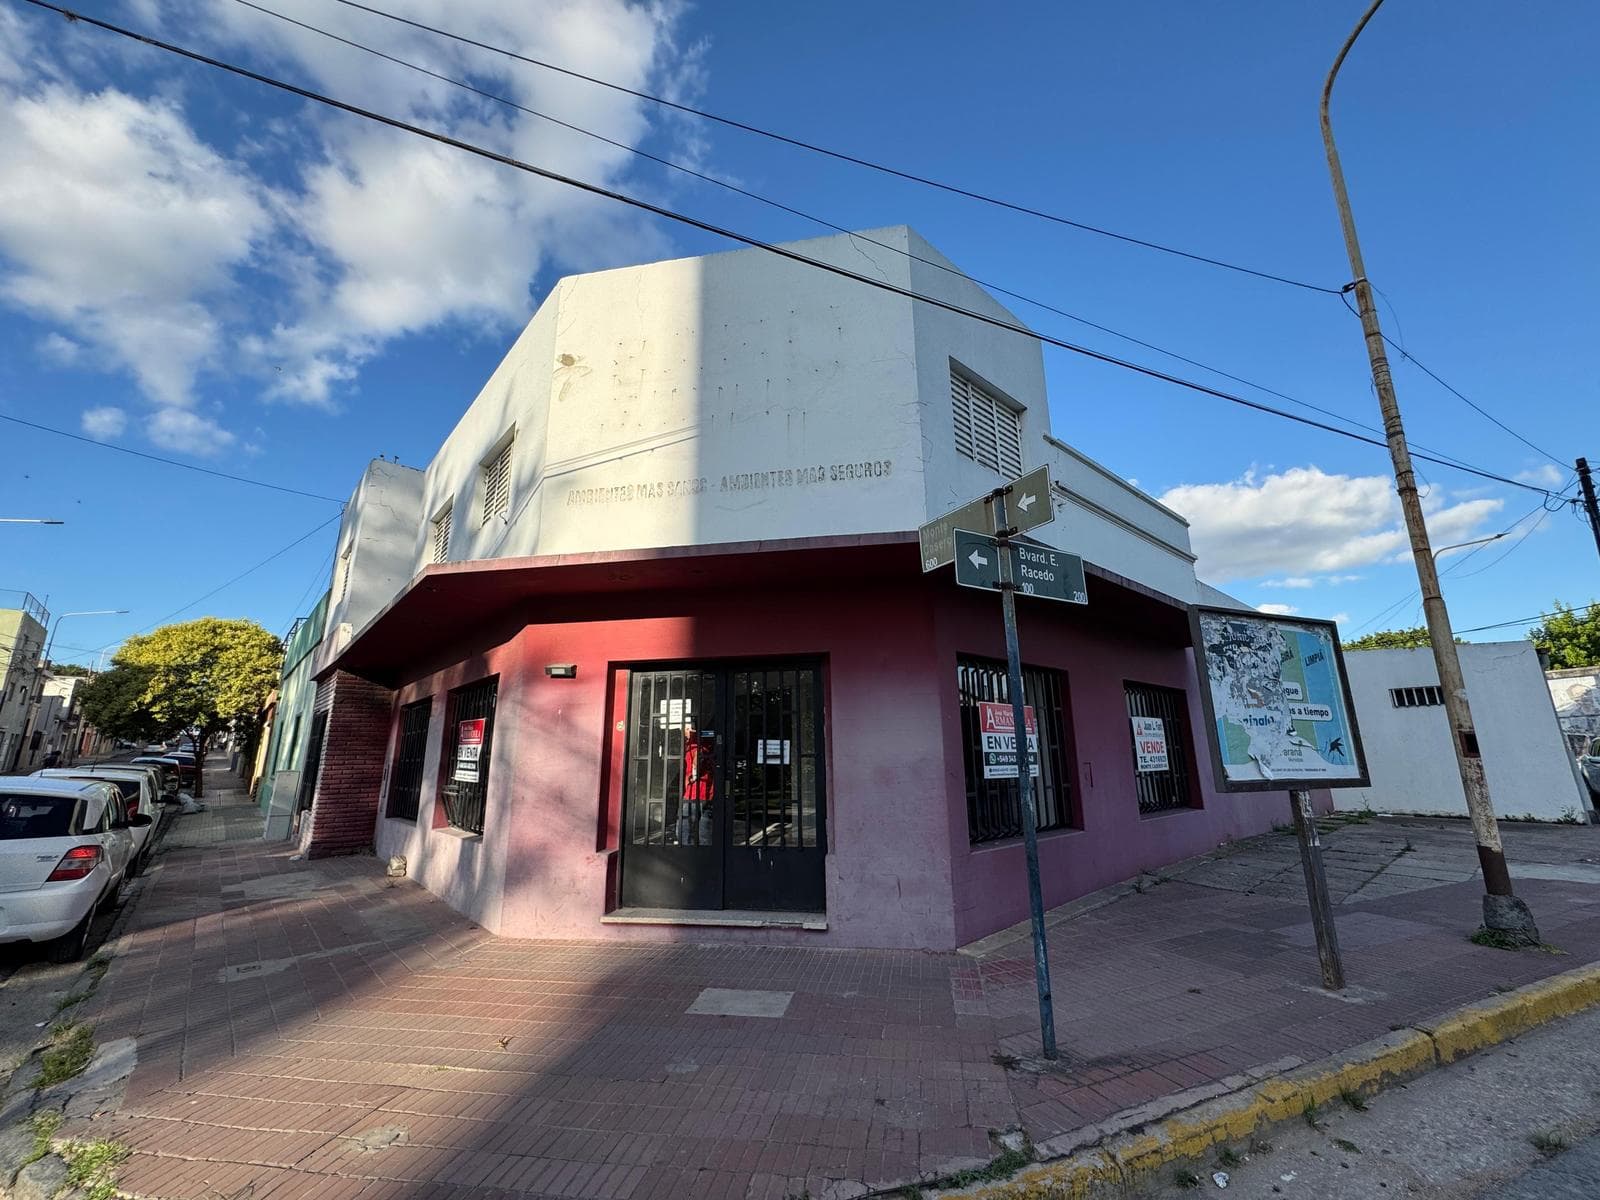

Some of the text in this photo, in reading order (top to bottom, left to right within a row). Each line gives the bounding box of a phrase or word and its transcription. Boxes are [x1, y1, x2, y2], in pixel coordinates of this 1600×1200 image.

[829, 460, 892, 481] SEGUROS
[1019, 547, 1059, 567] Bvard. E.
[1020, 564, 1055, 582] Racedo
[1022, 582, 1086, 602] 100 200
[1303, 706, 1329, 718] tiempo
[986, 735, 1035, 750] EN VEA
[1140, 740, 1165, 754] VENDE
